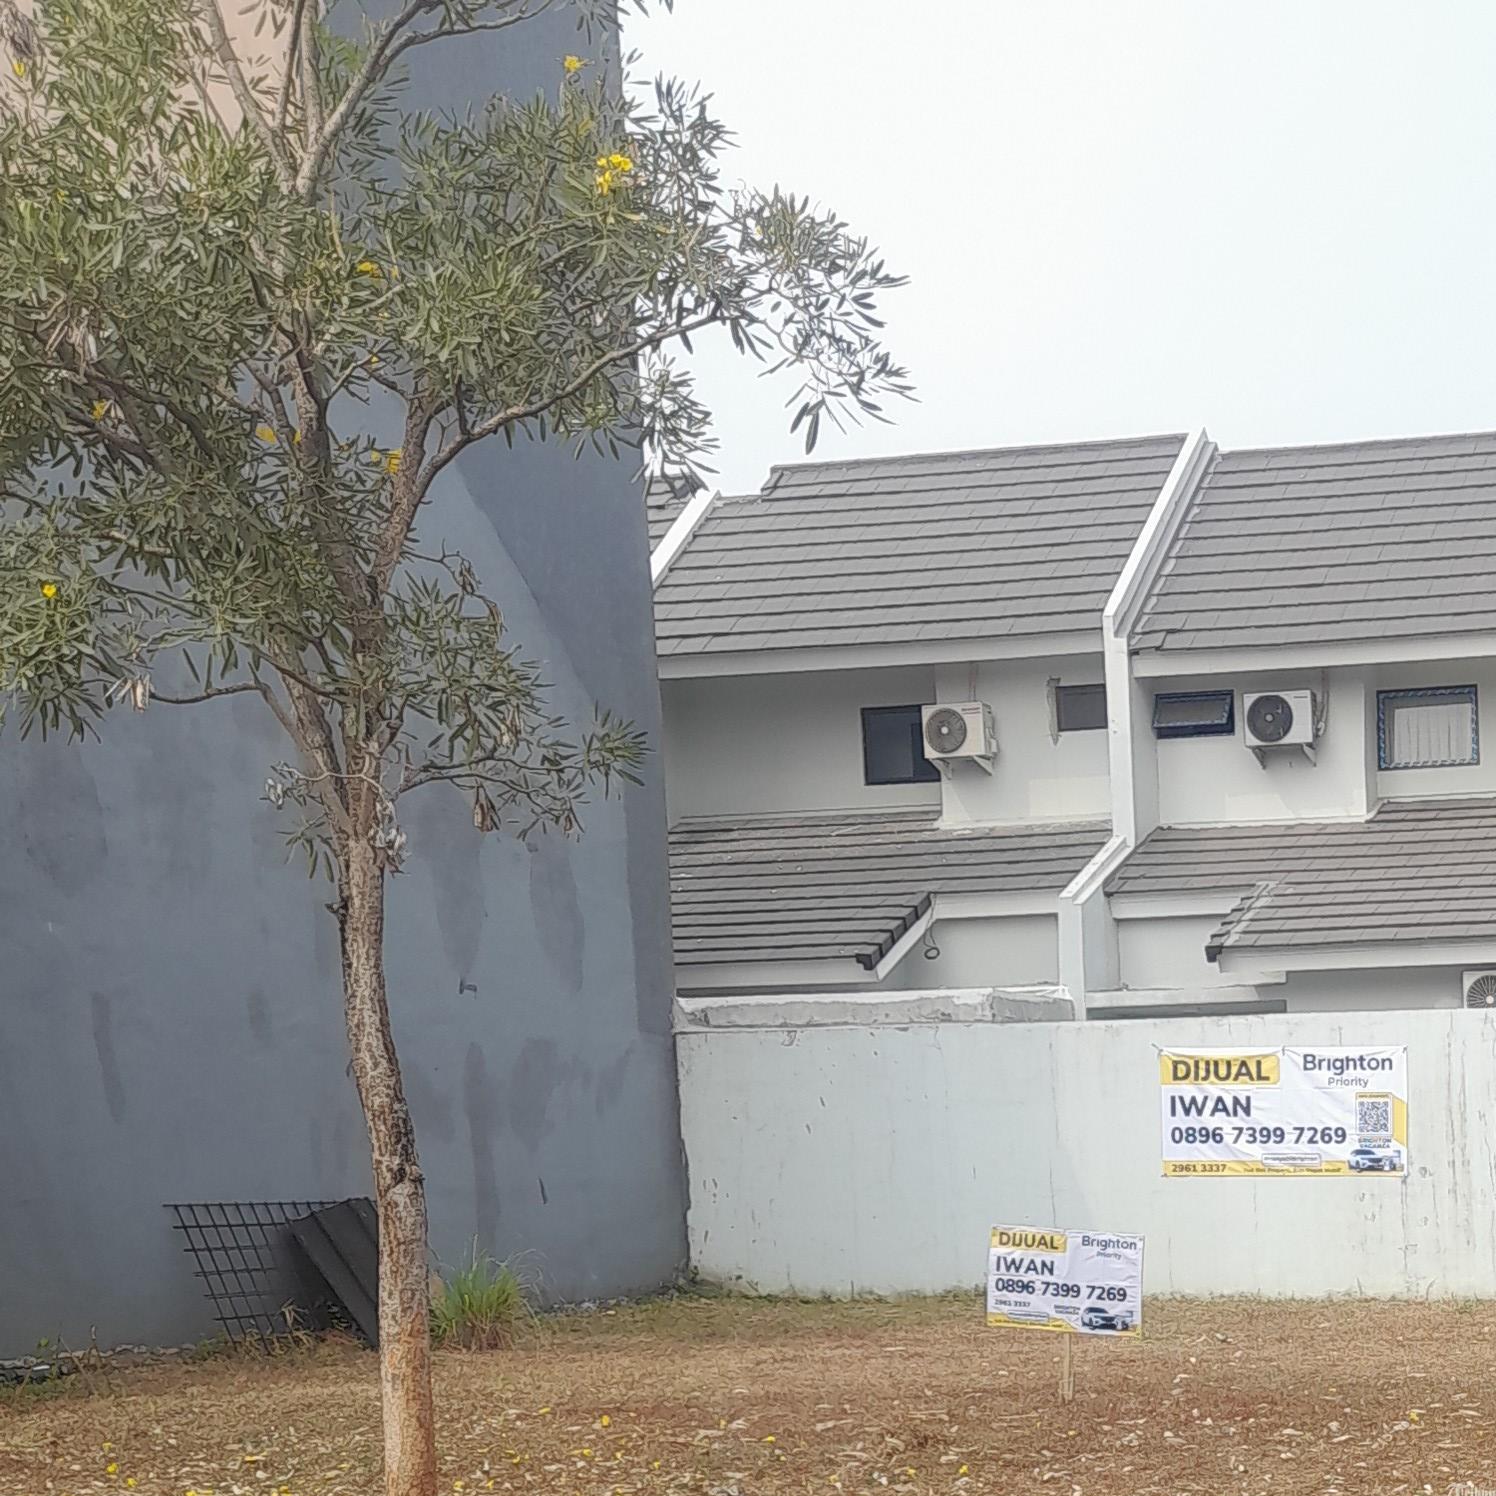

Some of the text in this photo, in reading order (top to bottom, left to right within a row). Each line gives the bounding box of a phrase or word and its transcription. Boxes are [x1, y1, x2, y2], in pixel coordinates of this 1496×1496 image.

[1171, 1059, 1271, 1082] DIJUAL
[1302, 1053, 1393, 1076] Brighton
[1327, 1076, 1369, 1088] Priority
[1170, 1095, 1252, 1118] IWAN
[1171, 1126, 1347, 1144] 0896 7399 7269
[1171, 1163, 1227, 1173] 2961 3337
[998, 1231, 1059, 1250] DIJUAL
[1081, 1235, 1137, 1251] Brighton
[995, 1255, 1055, 1276] IWAN
[995, 1278, 1127, 1302] 0896 7399 7269
